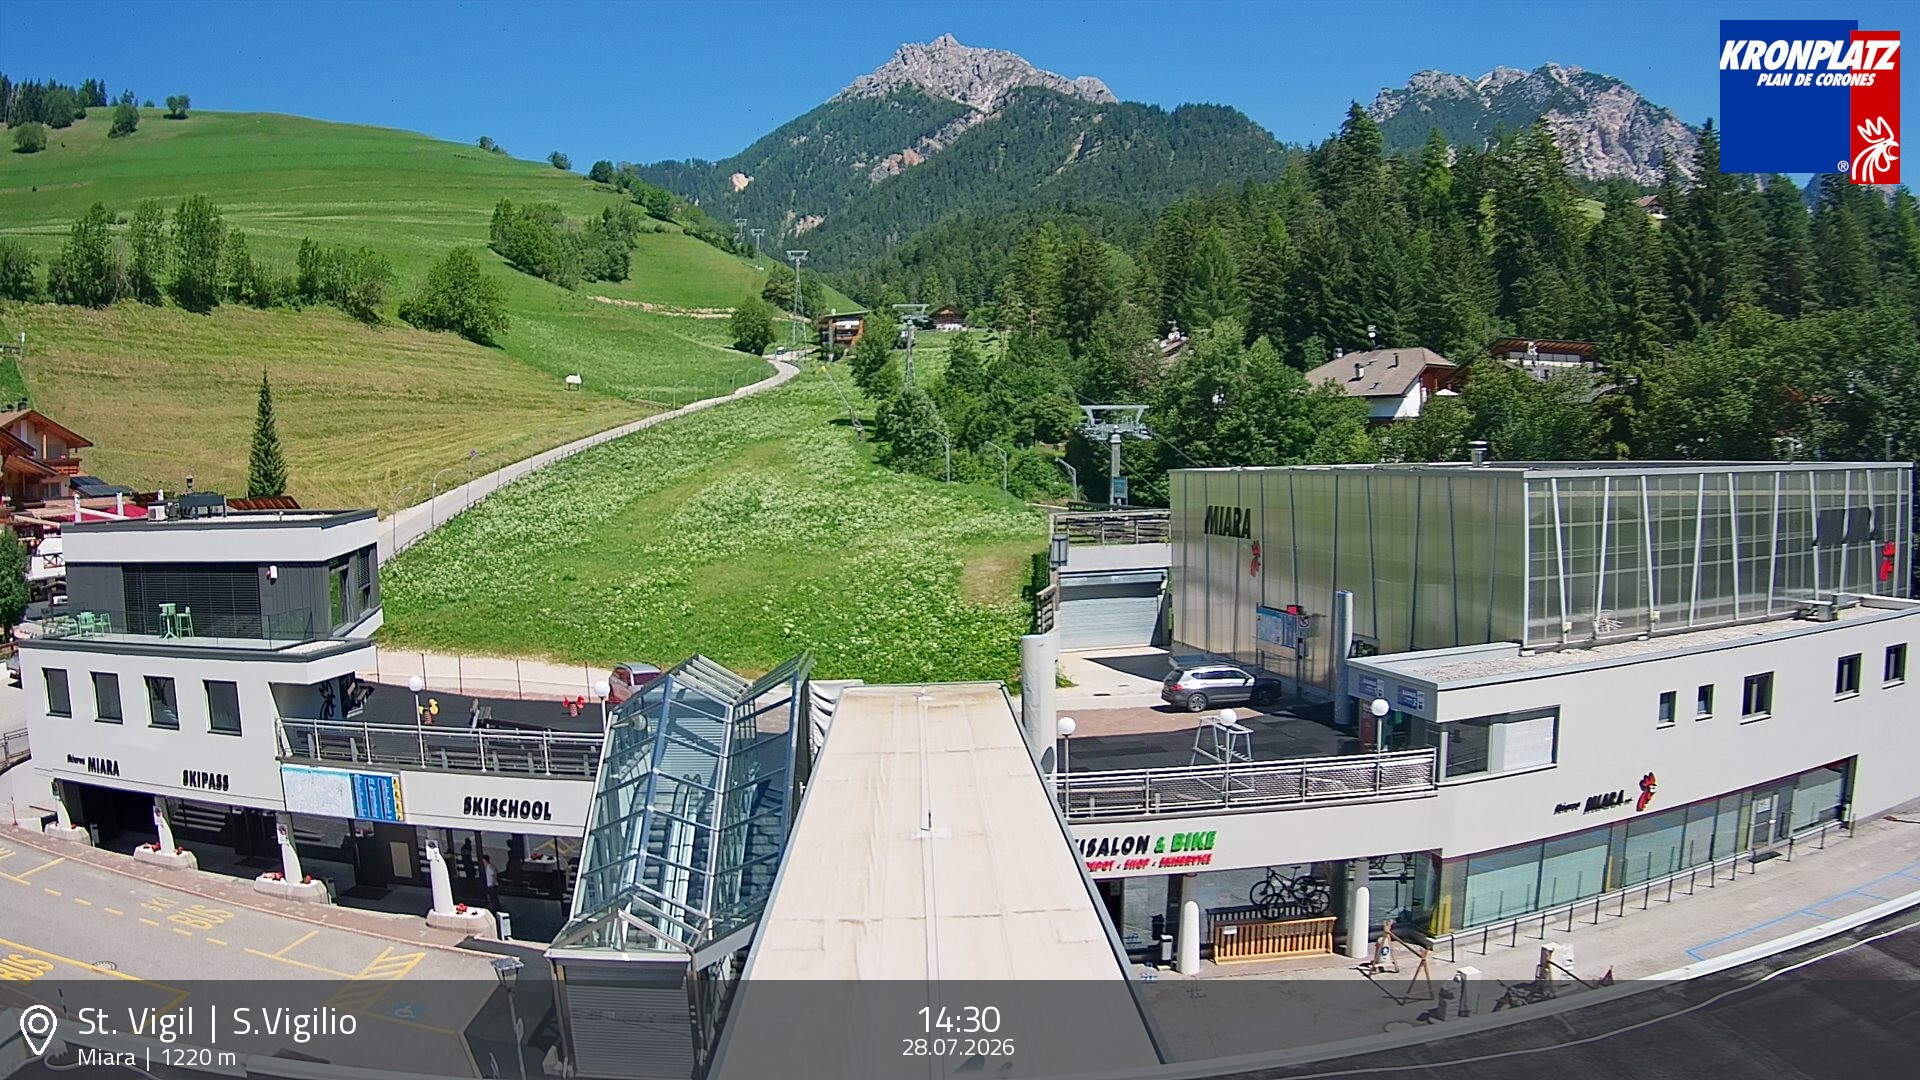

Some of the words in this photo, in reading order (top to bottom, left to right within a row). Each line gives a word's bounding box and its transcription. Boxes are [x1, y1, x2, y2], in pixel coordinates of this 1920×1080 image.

[1203, 505, 1251, 539] MIARA
[87, 756, 120, 777] MIARA
[182, 769, 229, 792] SKIPASS
[463, 796, 552, 821] SKISCHOOL
[1074, 835, 1151, 858] ISALON
[1170, 830, 1217, 853] BIKE
[167, 904, 235, 932] BUS
